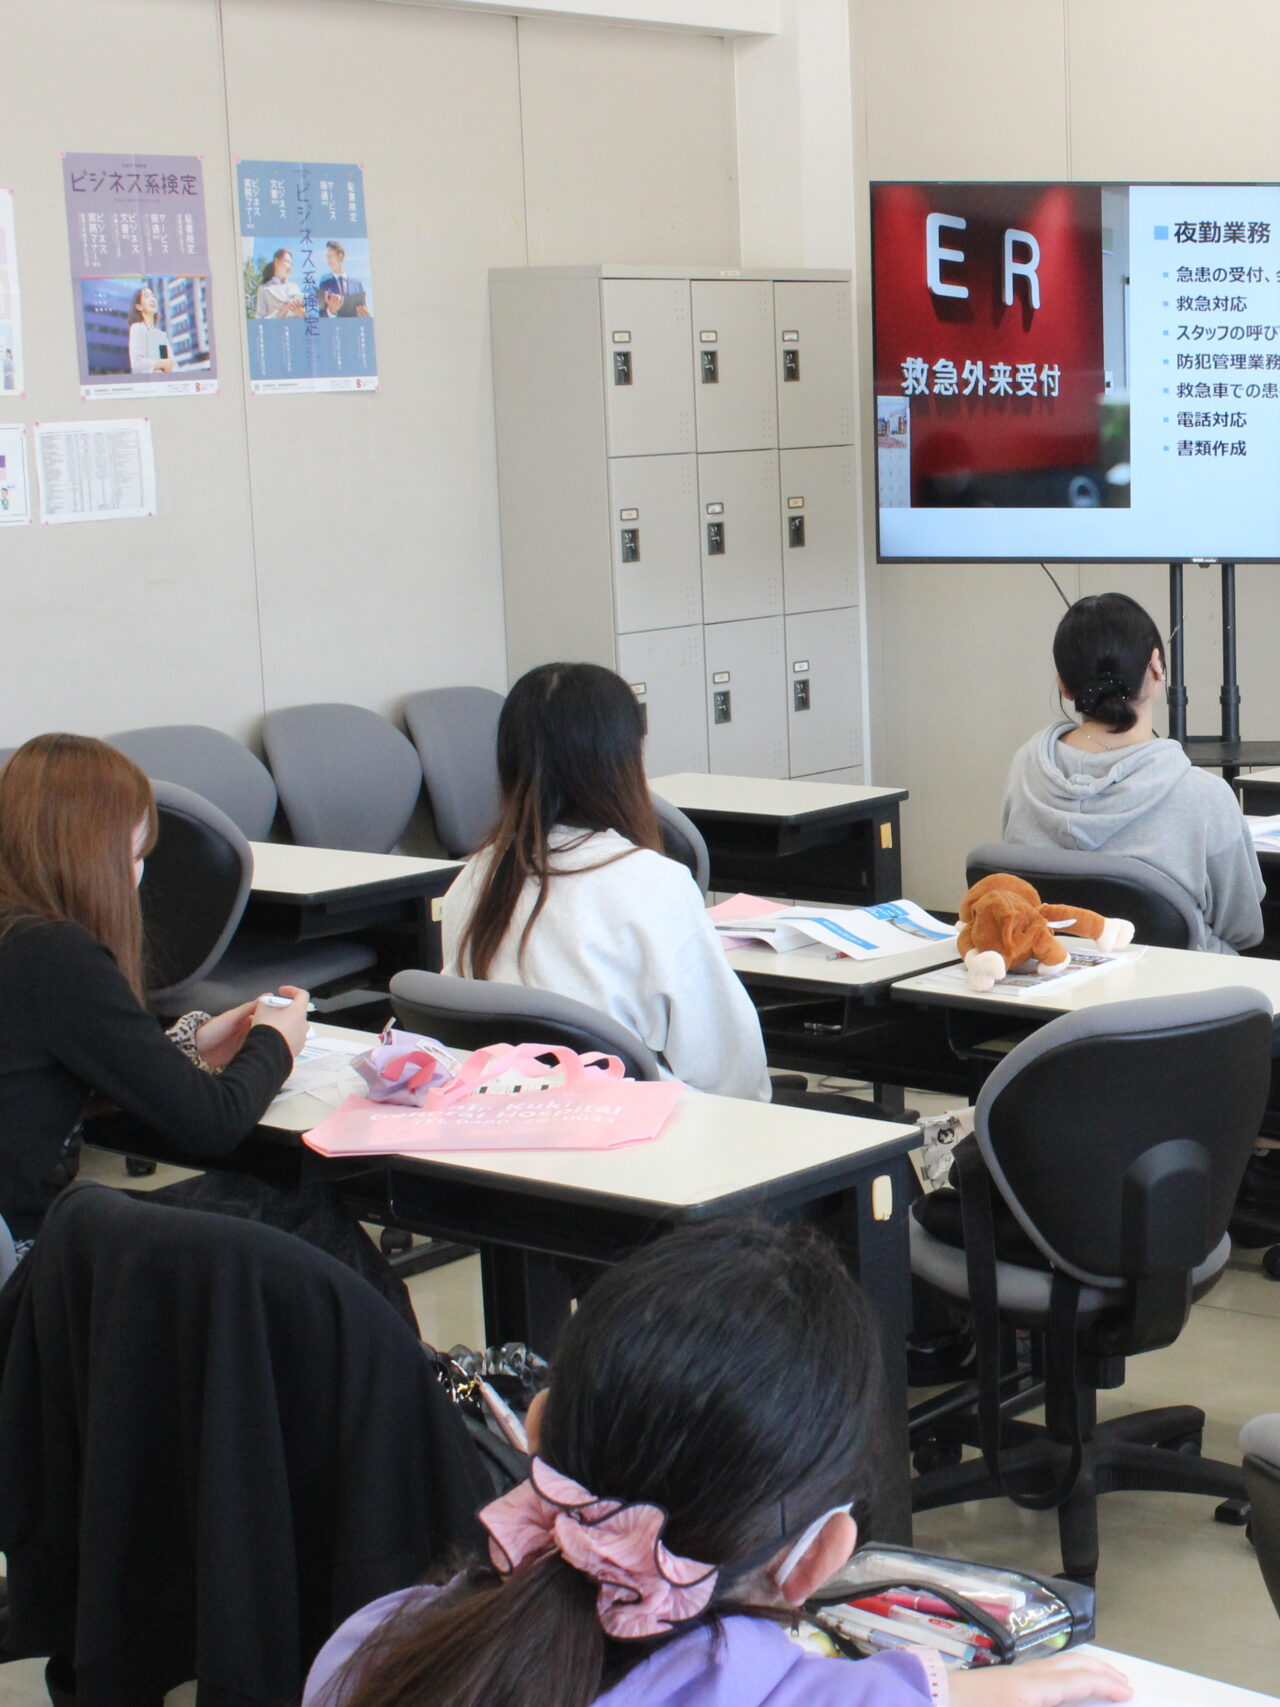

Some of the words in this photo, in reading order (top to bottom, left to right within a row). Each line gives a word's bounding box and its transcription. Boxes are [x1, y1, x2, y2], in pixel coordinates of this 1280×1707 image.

[71, 170, 198, 195] ビジネス系検定
[1174, 221, 1271, 244] 夜勤業務
[296, 181, 320, 336] ビジネス系検定
[1176, 296, 1247, 312] 救急対応
[901, 357, 1061, 397] 救急外来受付
[1176, 412, 1247, 428] 電話対応
[1176, 440, 1247, 457] 書類作成
